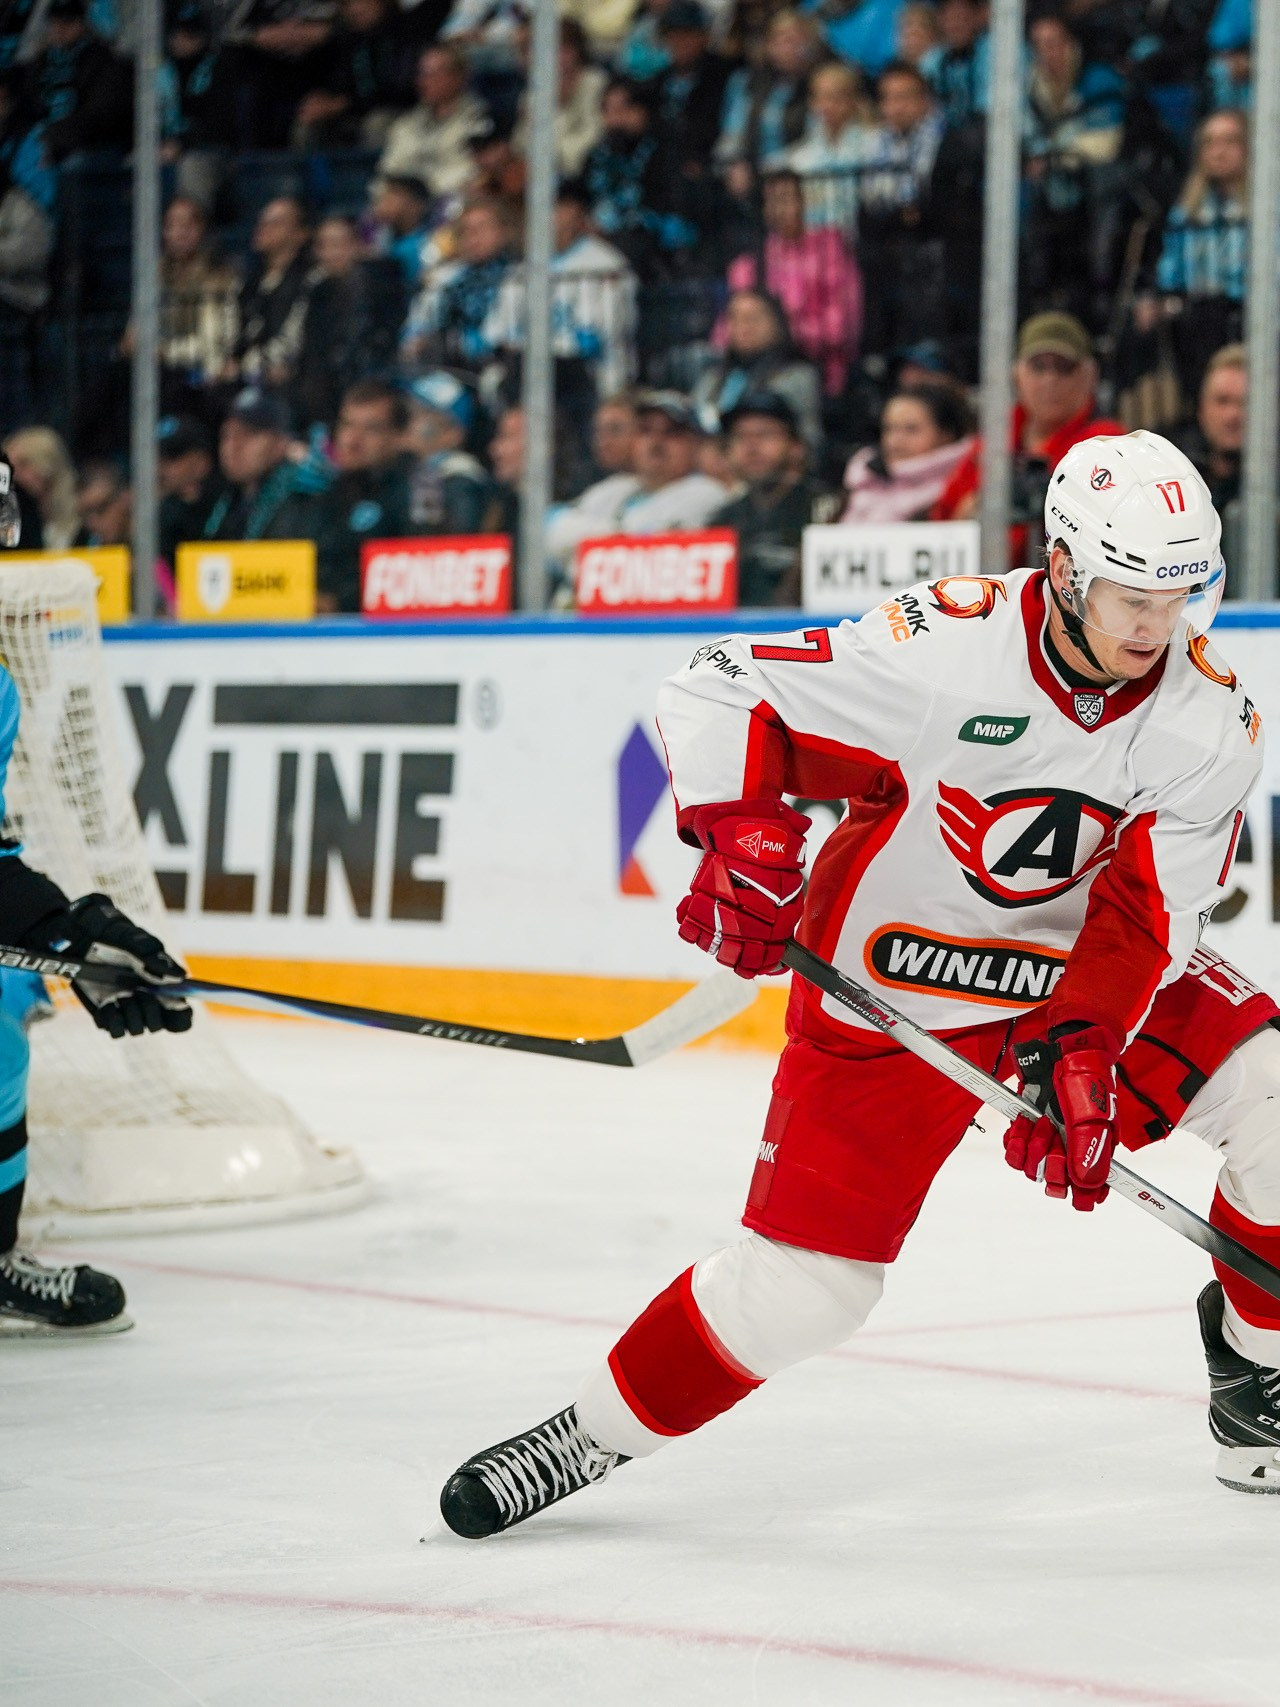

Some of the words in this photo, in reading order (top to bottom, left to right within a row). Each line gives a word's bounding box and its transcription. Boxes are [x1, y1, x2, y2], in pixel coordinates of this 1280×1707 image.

[1156, 481, 1186, 514] 17
[1051, 506, 1079, 533] CCM
[363, 548, 509, 610] FONBET
[579, 543, 736, 606] FONBET
[834, 991, 891, 1032] COMPOSITE
[1018, 1051, 1040, 1067] CCM
[1082, 1136, 1098, 1168] CCM
